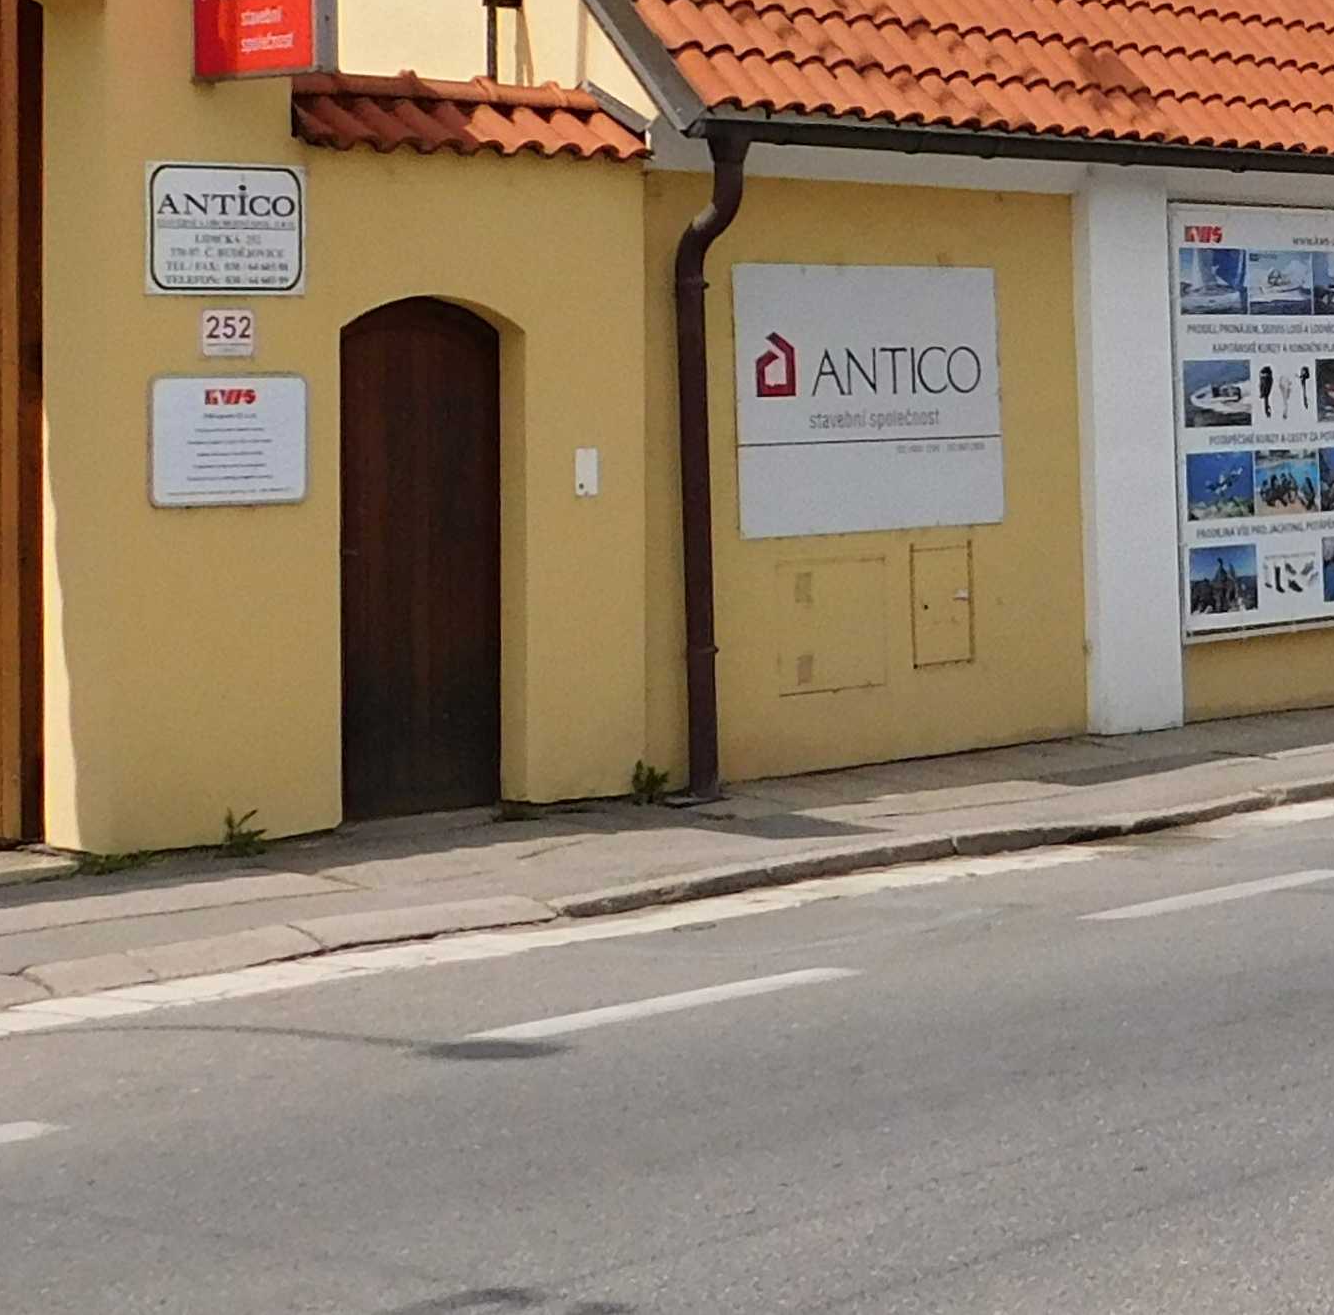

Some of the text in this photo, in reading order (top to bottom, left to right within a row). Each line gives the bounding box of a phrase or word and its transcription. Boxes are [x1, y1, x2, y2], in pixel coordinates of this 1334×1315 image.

[206, 316, 252, 339] 252
[812, 346, 981, 397] ANTICO
[809, 408, 940, 431] stavební společnost
